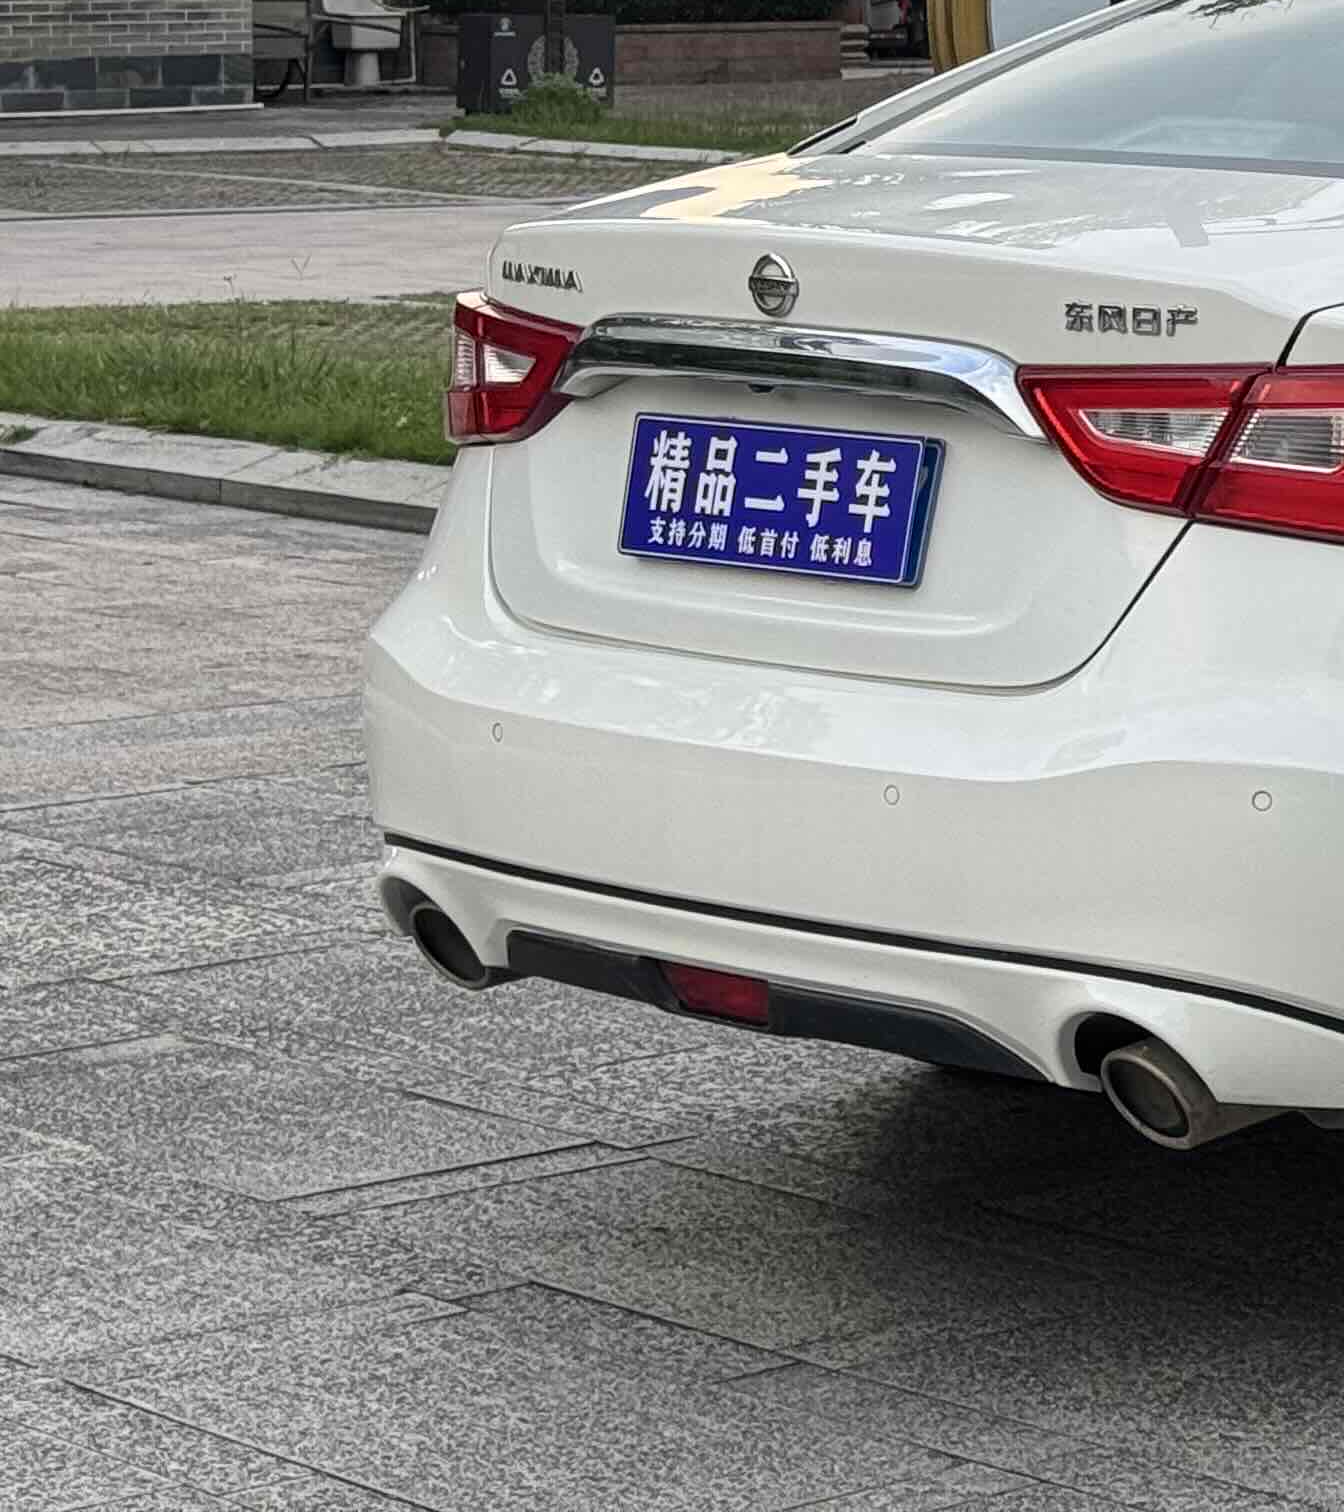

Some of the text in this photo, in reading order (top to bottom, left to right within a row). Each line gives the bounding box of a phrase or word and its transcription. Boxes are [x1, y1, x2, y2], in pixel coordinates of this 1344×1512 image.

[1064, 300, 1199, 338] 东风日产
[645, 430, 897, 534] 精品二手车
[648, 517, 873, 567] 支持分期 低首付 低利息
